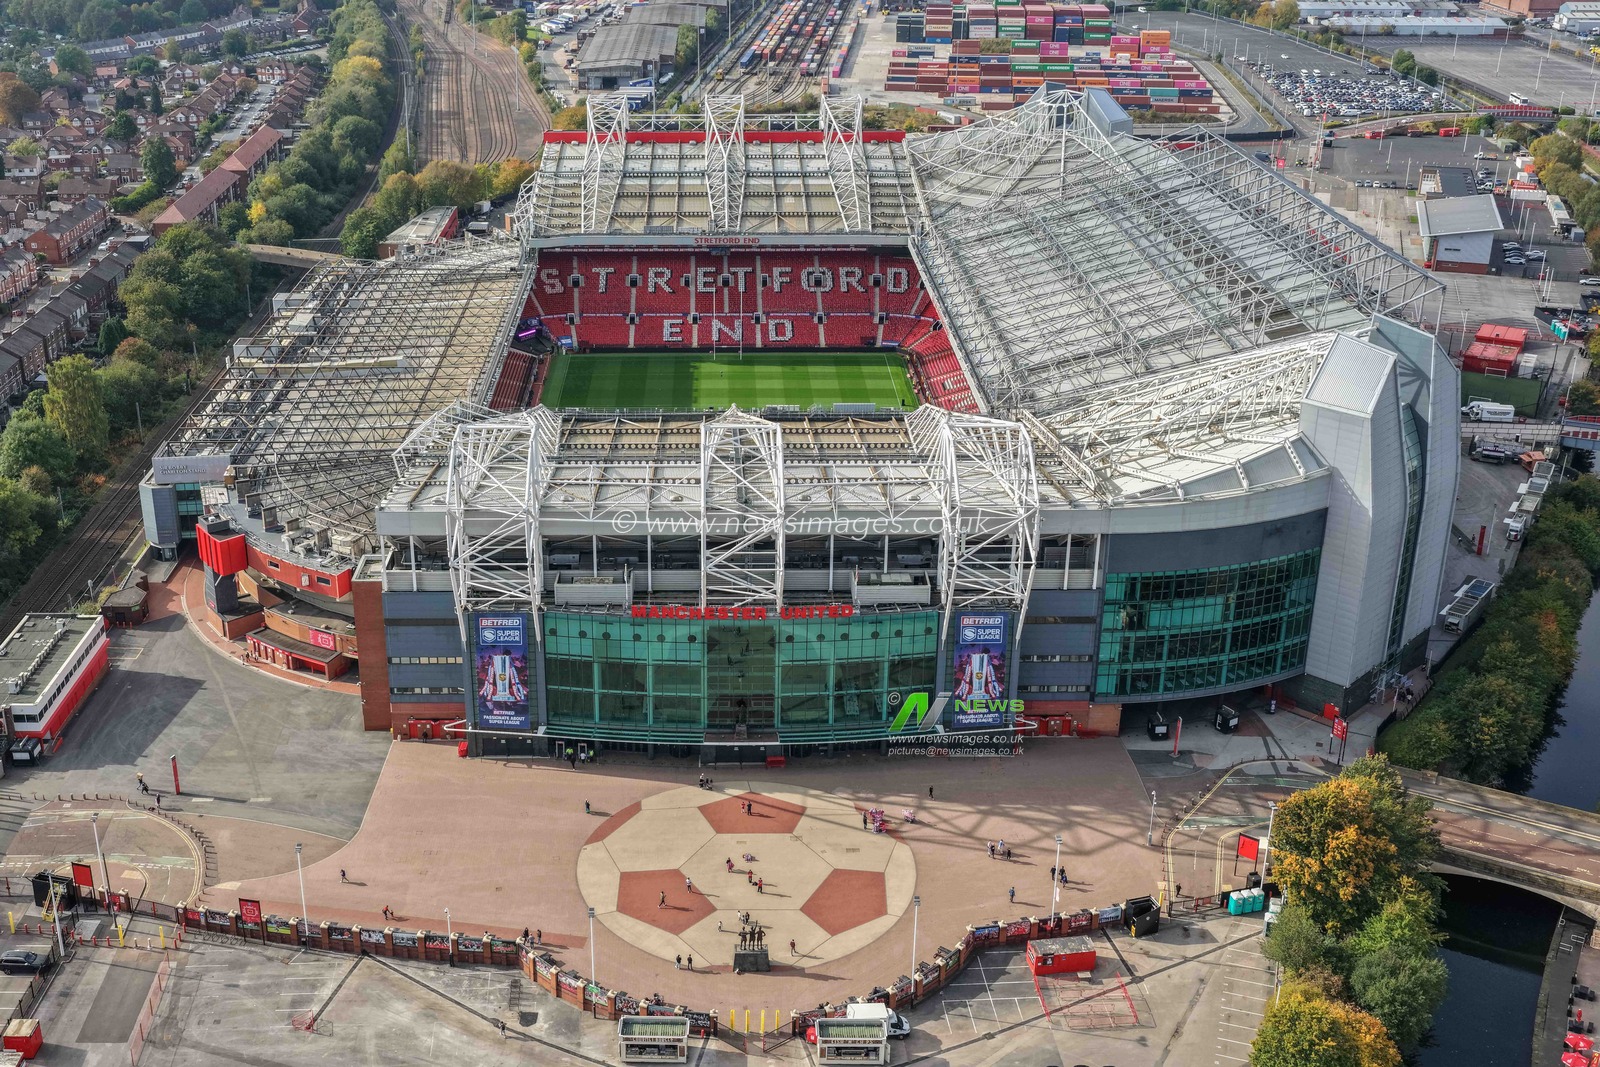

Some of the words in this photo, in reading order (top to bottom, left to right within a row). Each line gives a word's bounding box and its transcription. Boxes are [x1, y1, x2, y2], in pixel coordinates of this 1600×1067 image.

[540, 267, 909, 294] STRETFORD
[663, 319, 793, 342] END
[631, 605, 767, 621] MANCHESTER
[780, 604, 854, 620] UNITED
